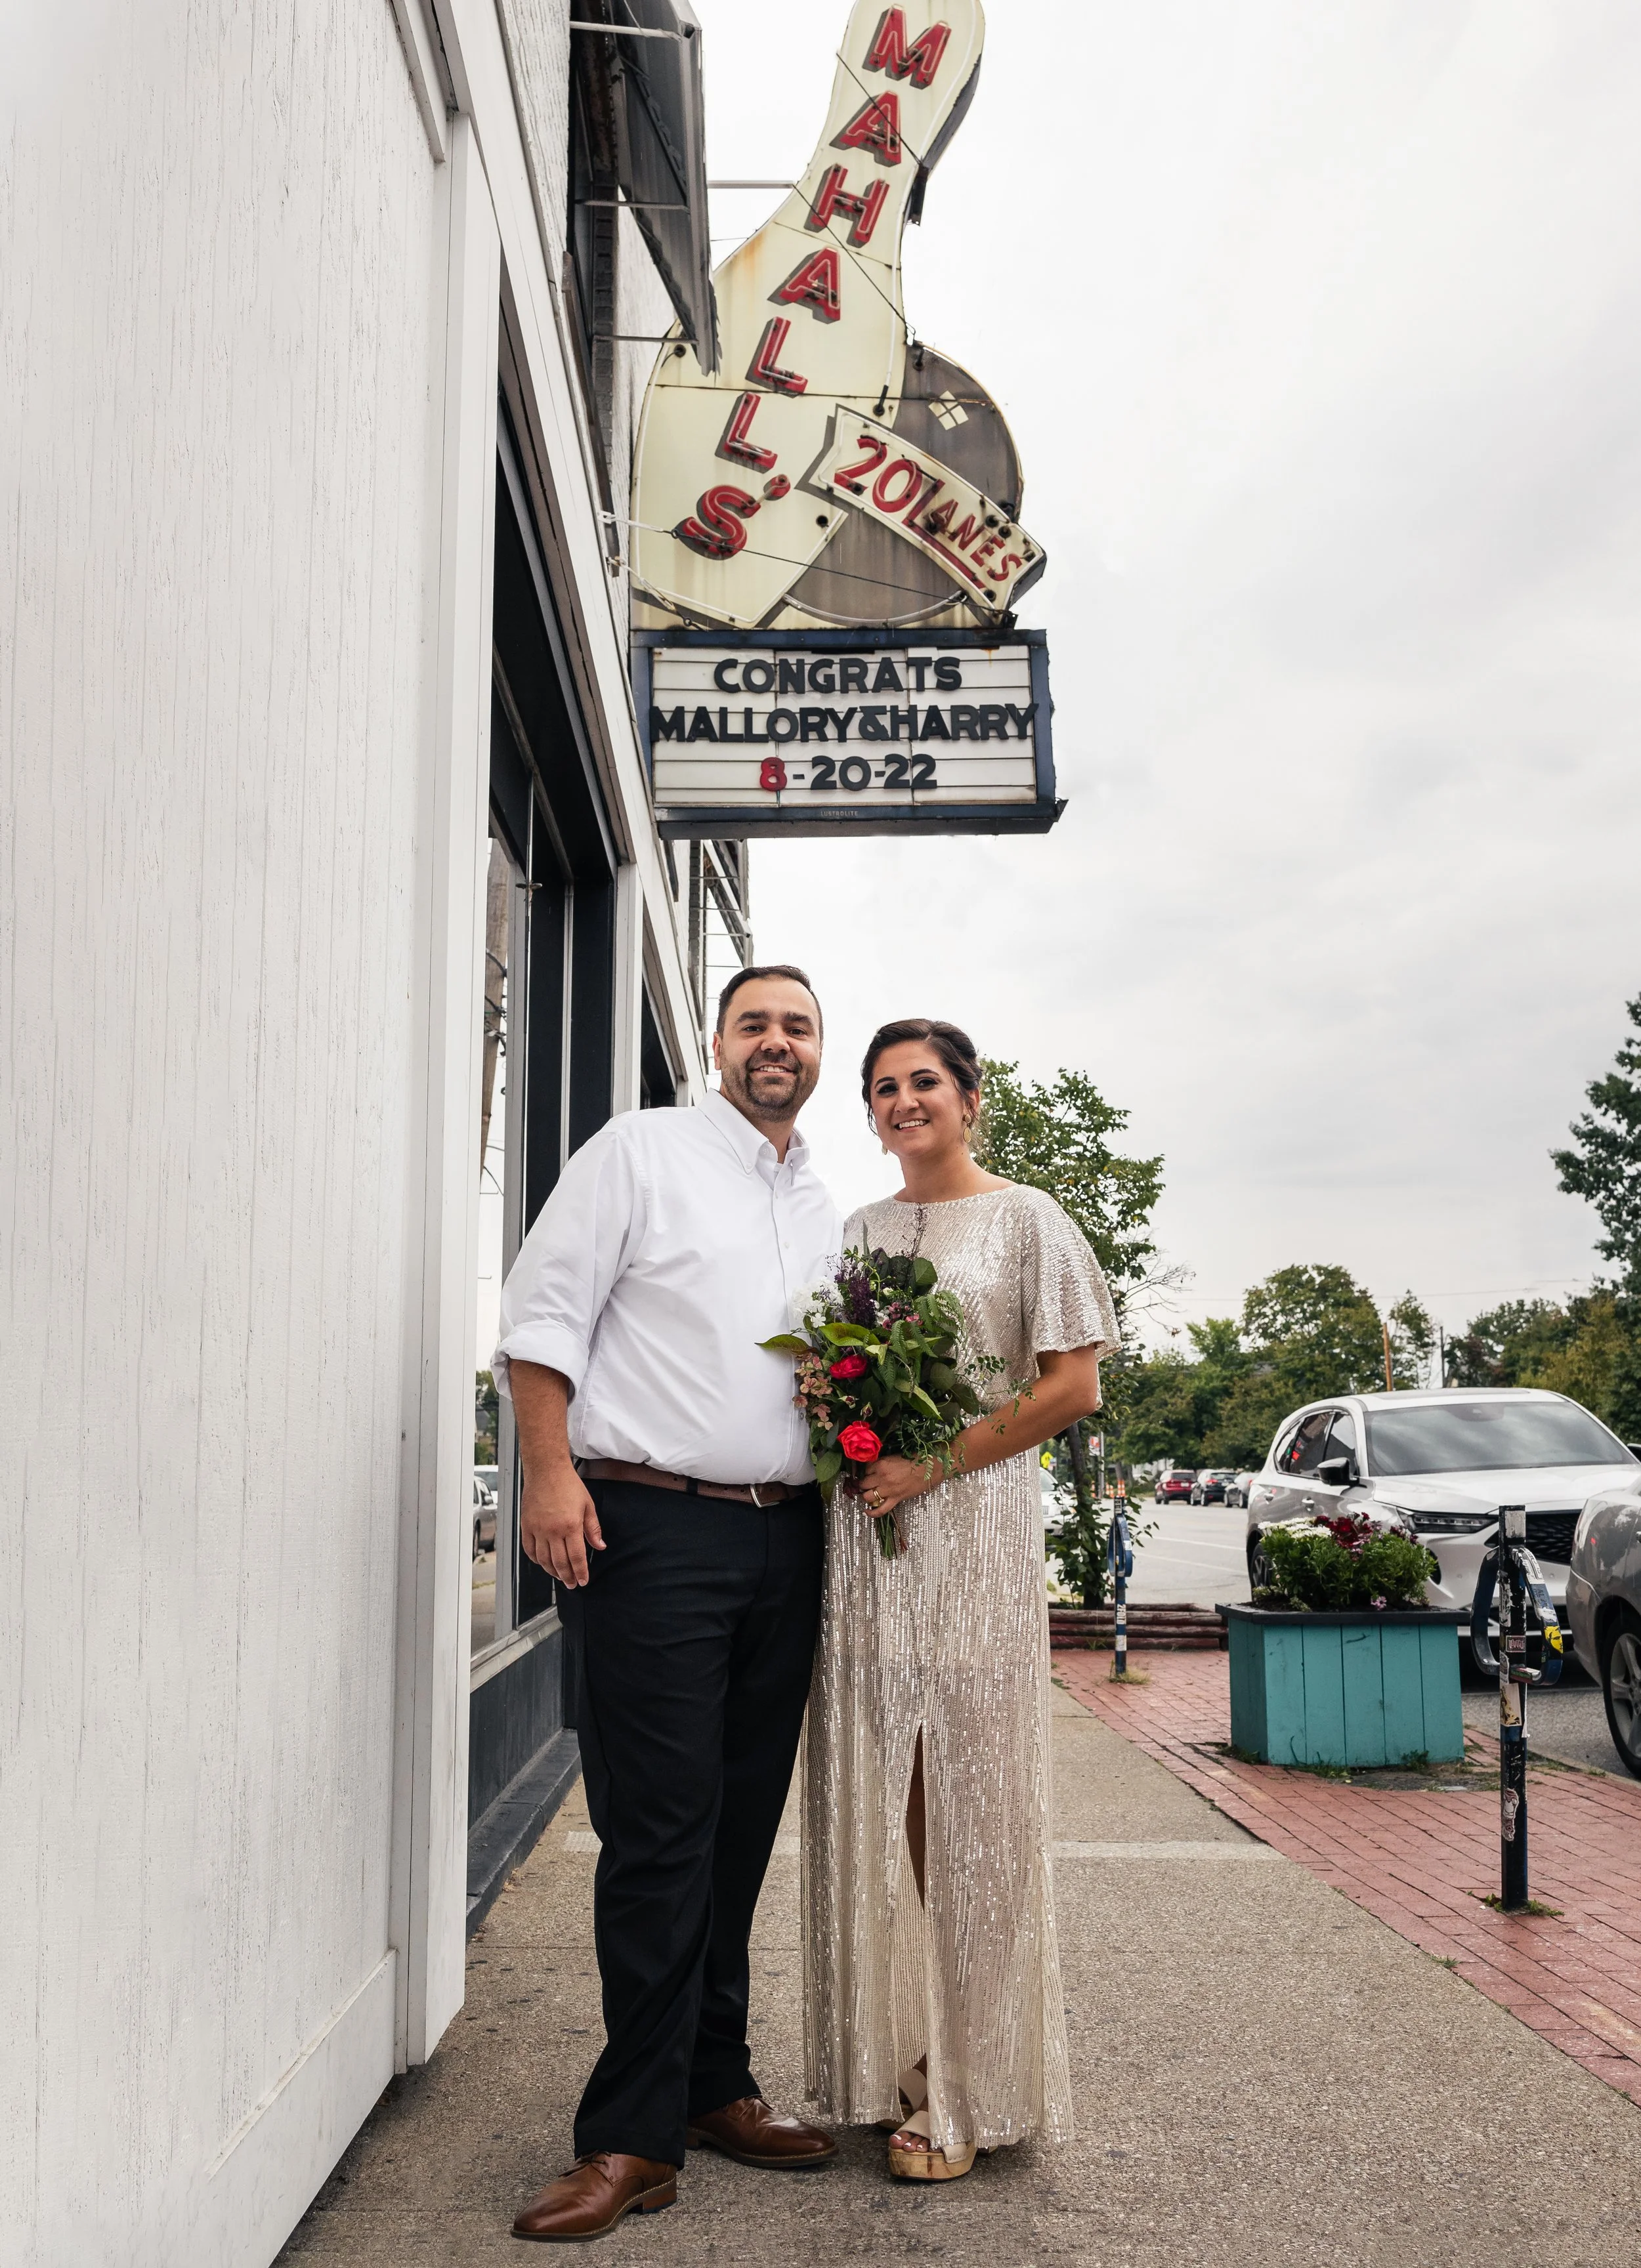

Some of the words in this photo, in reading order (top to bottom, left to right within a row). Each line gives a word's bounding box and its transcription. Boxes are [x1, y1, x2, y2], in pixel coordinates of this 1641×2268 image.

[834, 438, 923, 513] 20
[901, 478, 1023, 589] LANES
[714, 656, 962, 694] CONGRATS
[759, 753, 938, 791] 8-20-22
